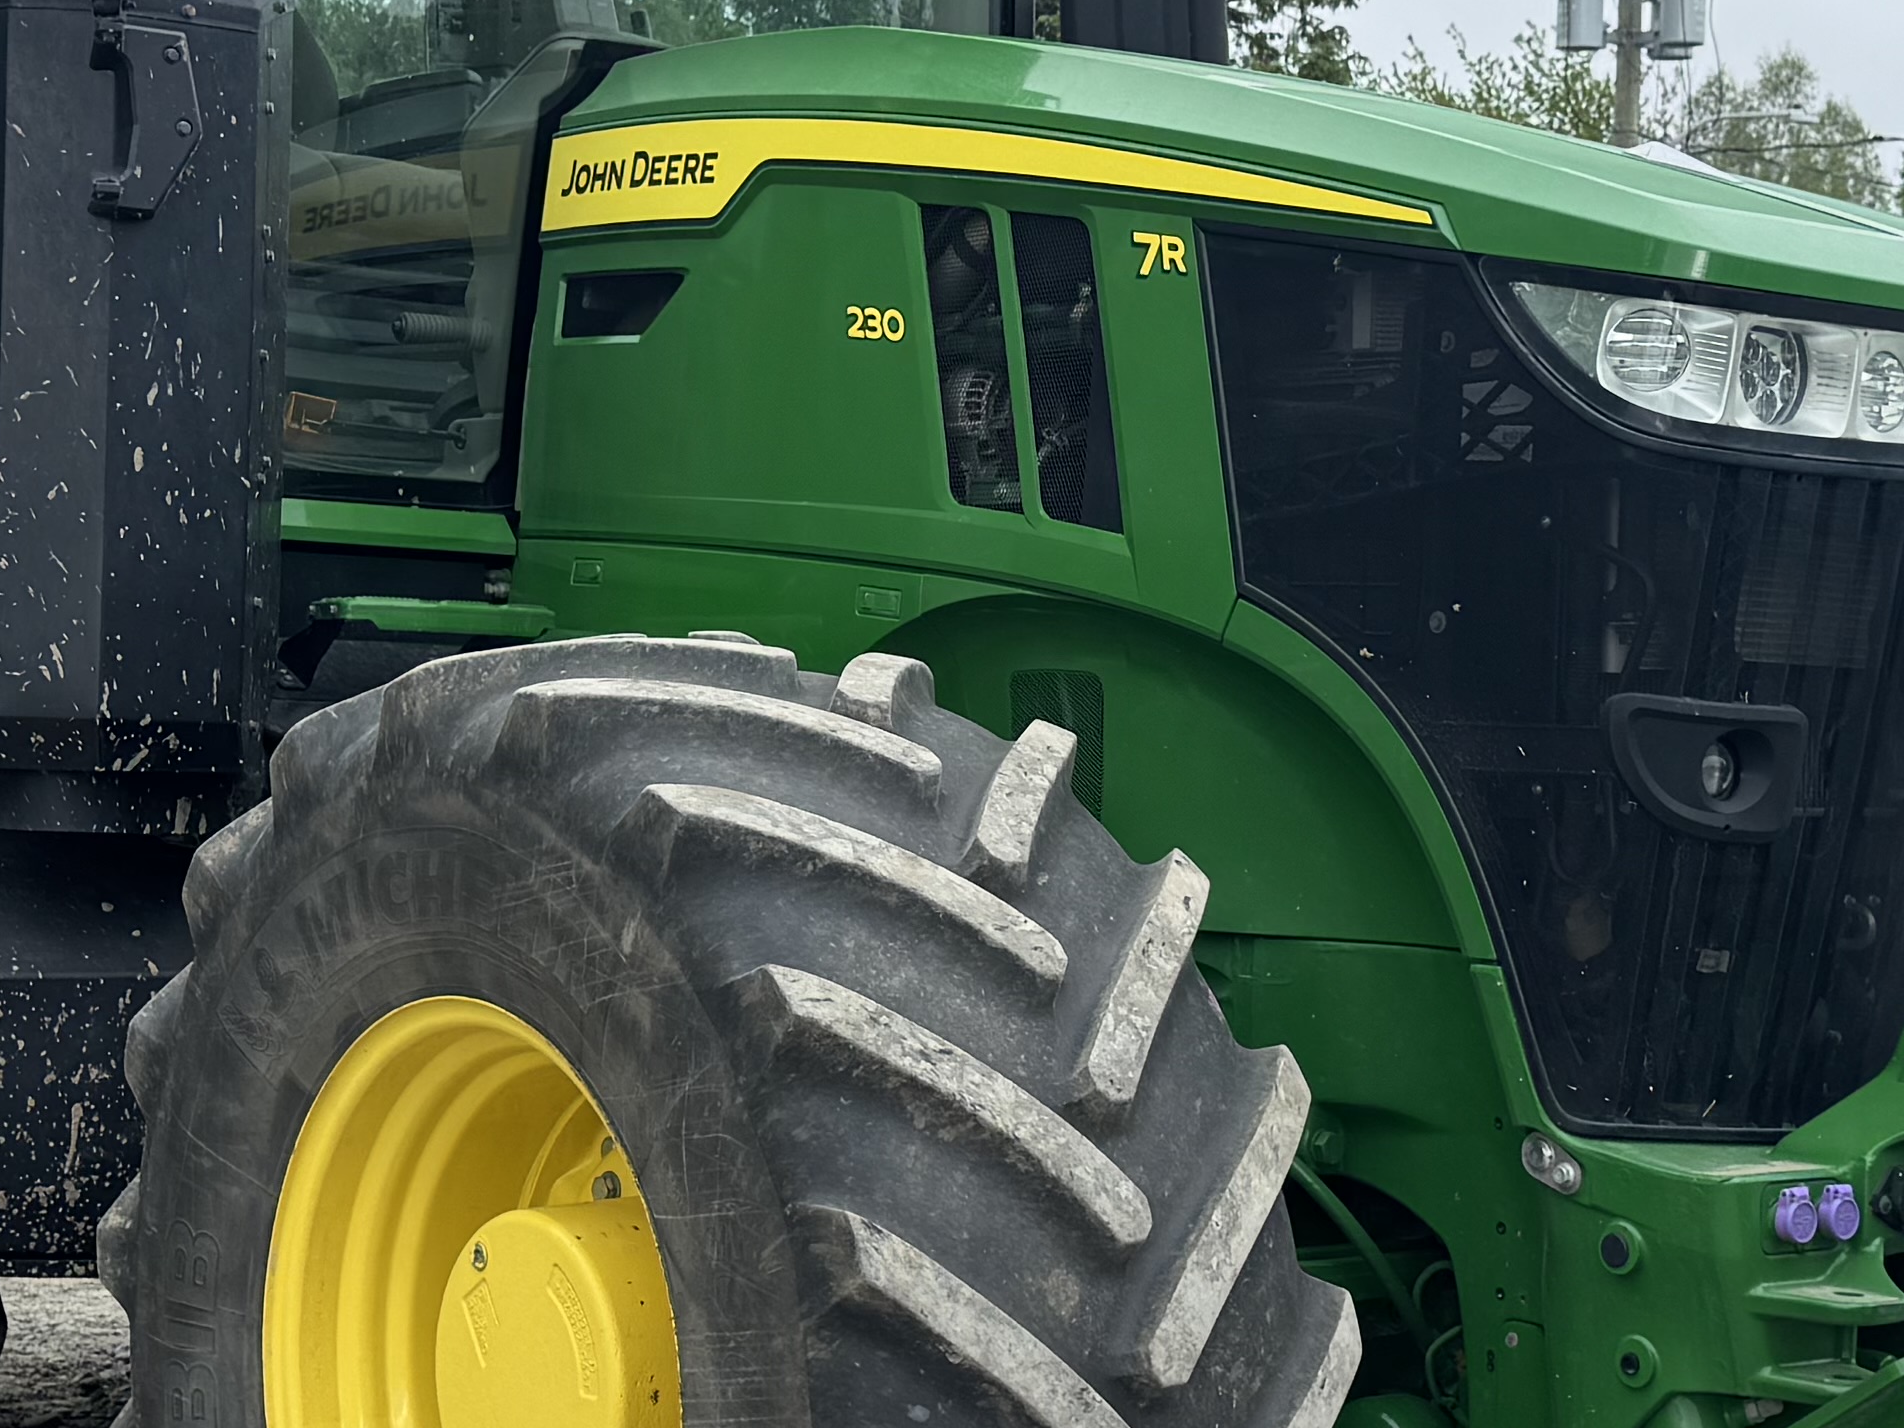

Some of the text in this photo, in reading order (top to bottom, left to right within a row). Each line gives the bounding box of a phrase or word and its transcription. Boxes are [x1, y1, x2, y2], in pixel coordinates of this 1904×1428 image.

[561, 150, 718, 197] JOHN DEERE
[1132, 231, 1187, 276] 7R
[846, 305, 906, 342] 230
